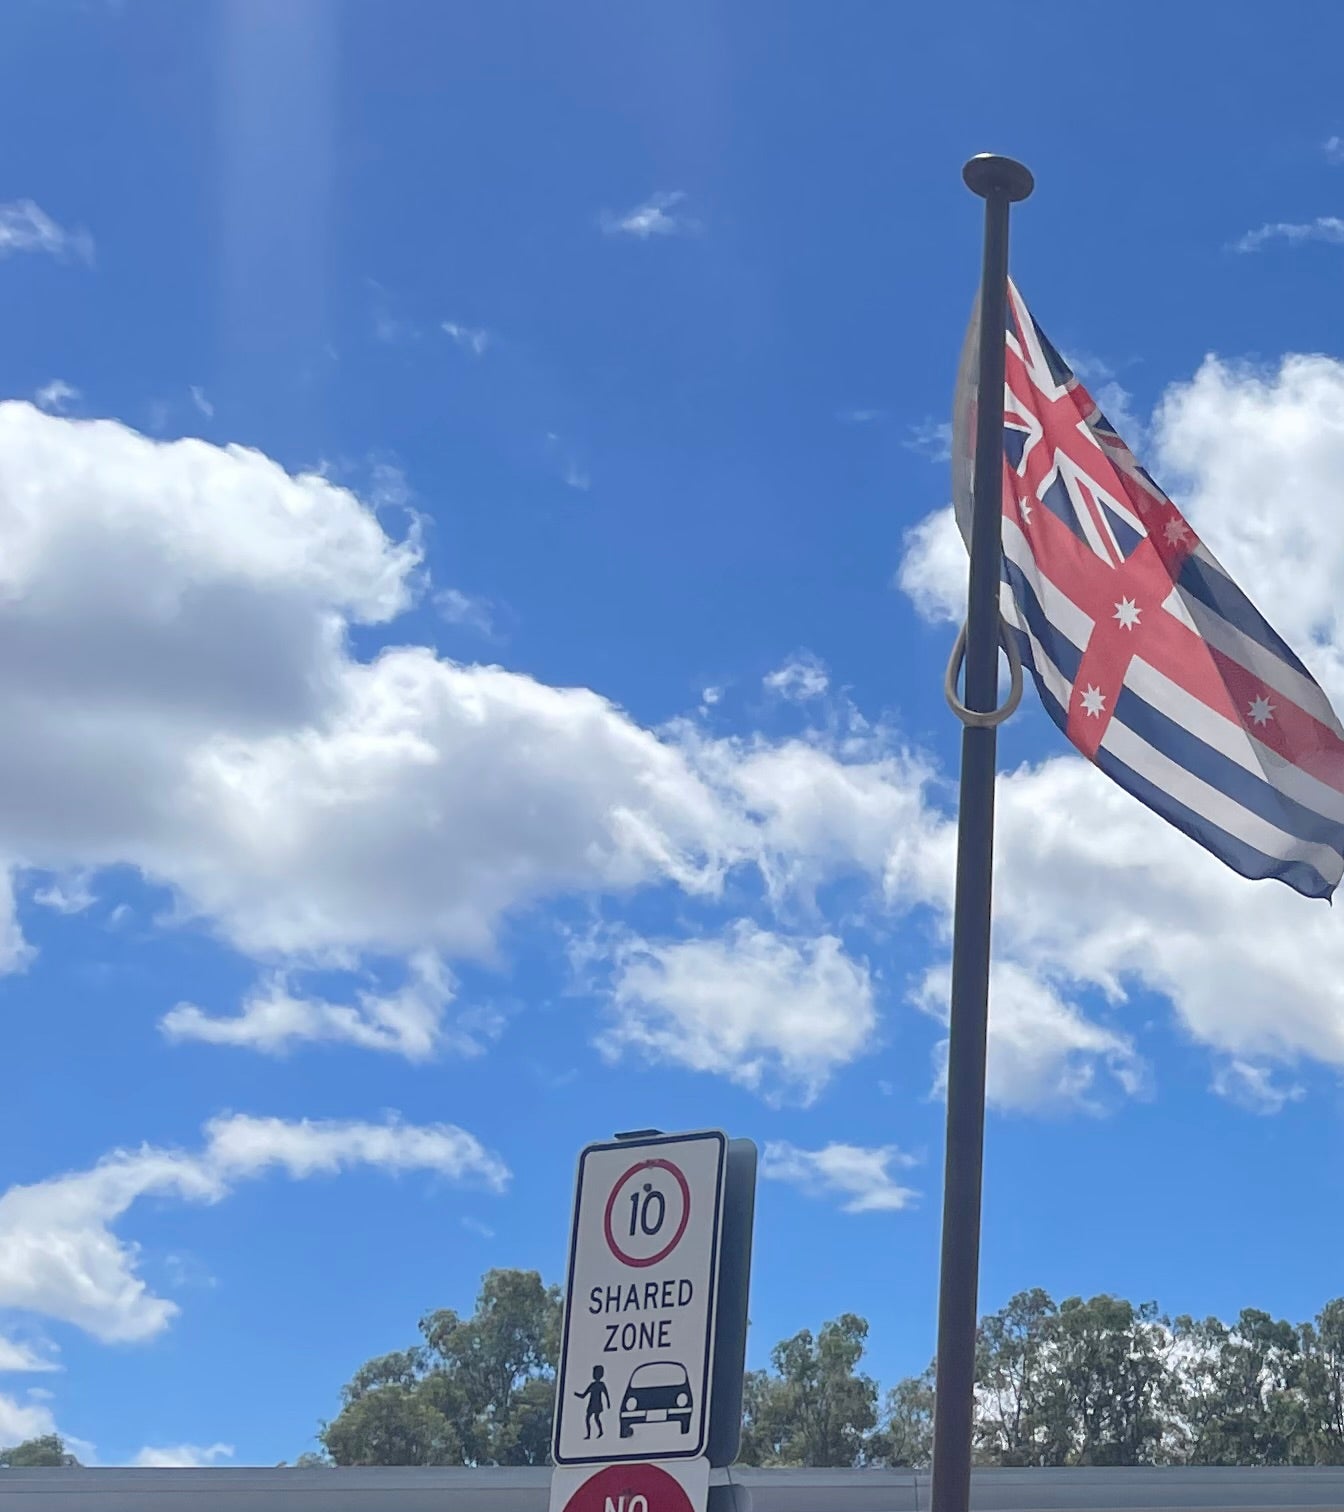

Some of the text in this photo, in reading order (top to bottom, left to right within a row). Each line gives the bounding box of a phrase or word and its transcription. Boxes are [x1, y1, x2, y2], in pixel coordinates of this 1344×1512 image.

[629, 1190, 666, 1236] 10
[589, 1279, 693, 1314] SHARED
[603, 1320, 672, 1352] ZONE
